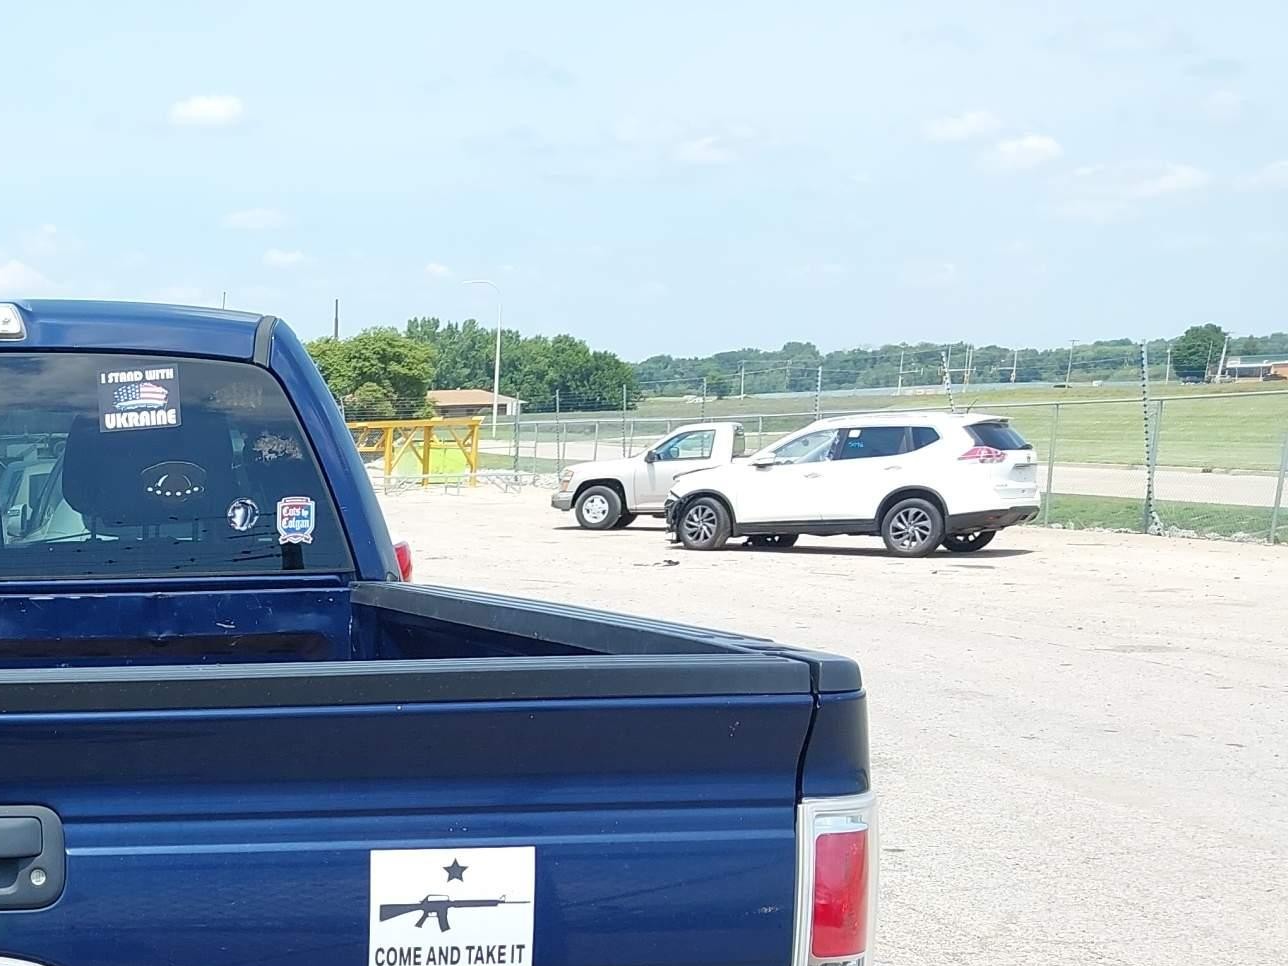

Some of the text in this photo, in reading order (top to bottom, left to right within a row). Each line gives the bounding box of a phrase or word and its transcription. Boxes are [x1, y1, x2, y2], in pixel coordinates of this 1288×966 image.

[100, 368, 174, 384] I STAND WITH
[104, 409, 177, 429] UKRAINE
[374, 944, 526, 966] COME AND TAKE IT
